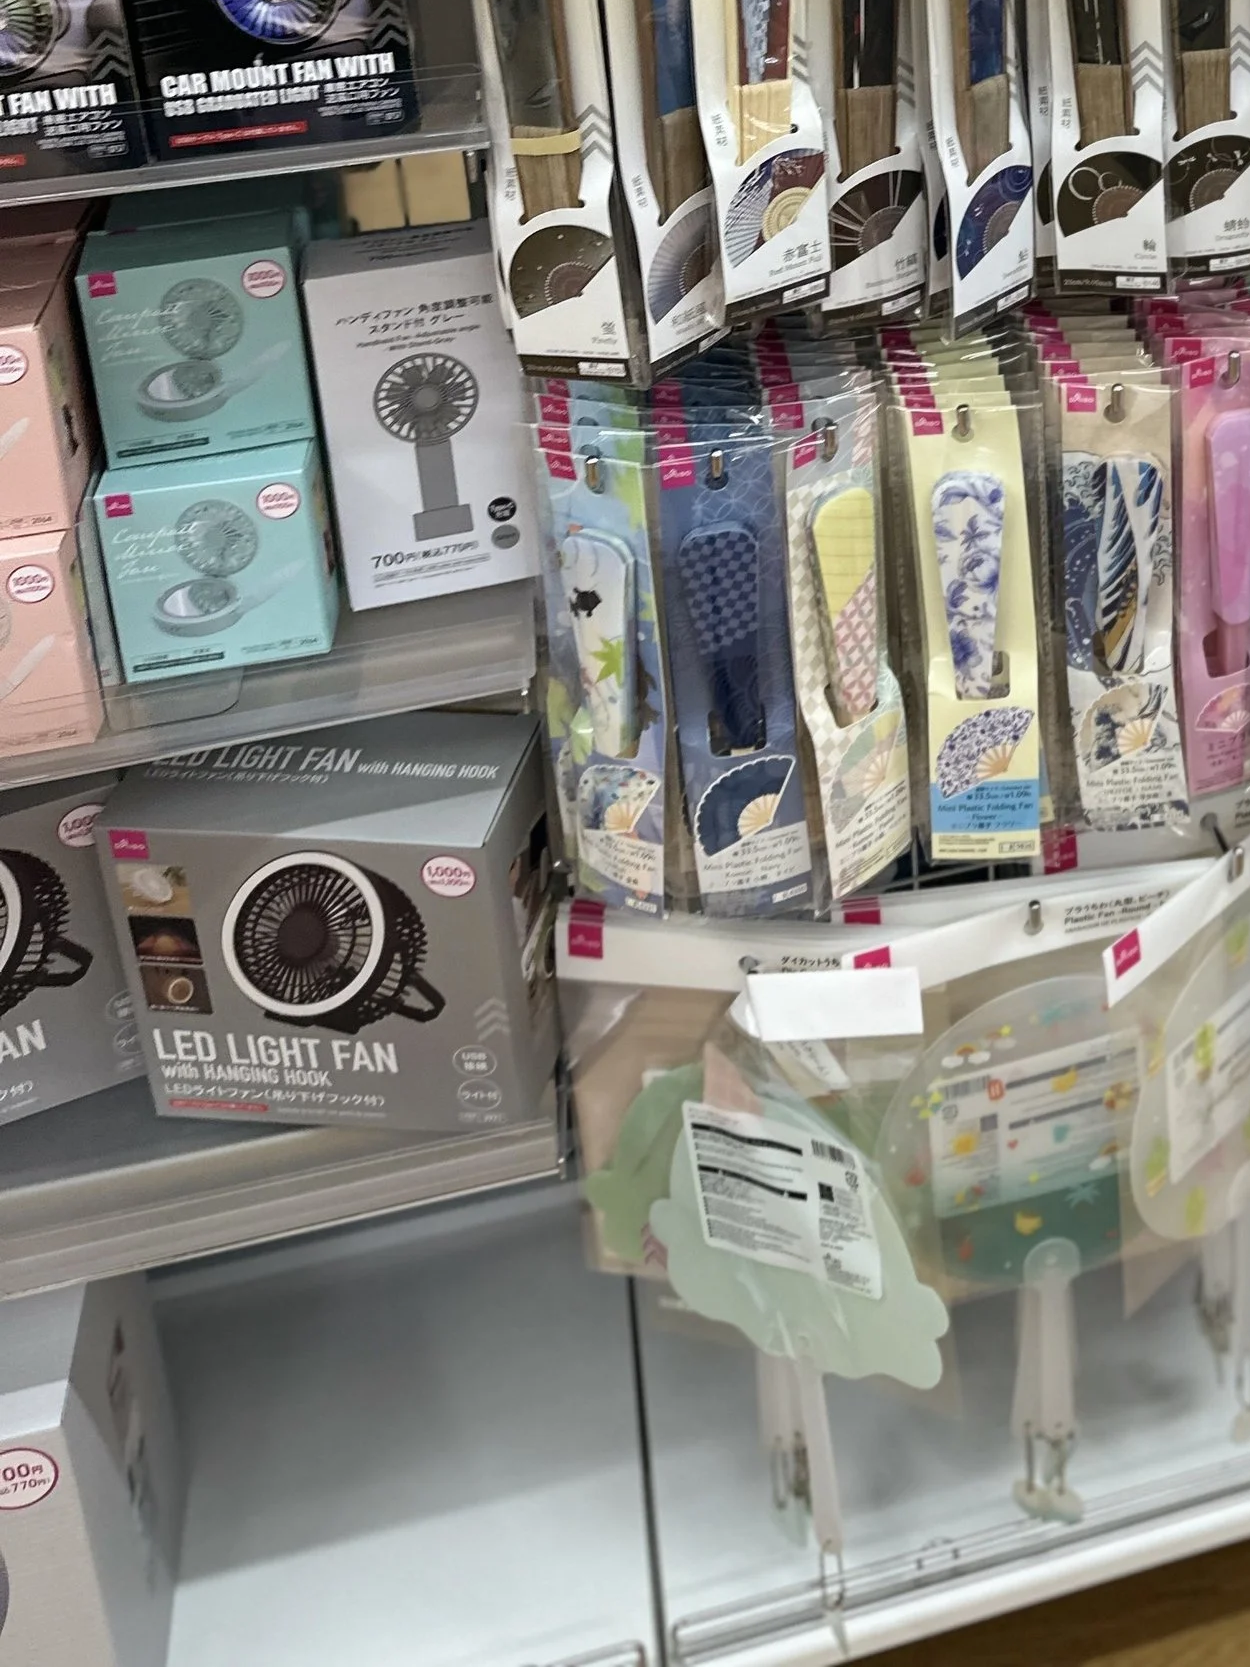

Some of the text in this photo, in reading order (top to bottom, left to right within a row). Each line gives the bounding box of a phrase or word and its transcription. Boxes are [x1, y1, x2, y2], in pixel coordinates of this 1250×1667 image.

[160, 51, 396, 98] CAR MOUNT FAN WITH
[9, 82, 118, 117] FAN WITH
[783, 240, 822, 263] 赤富士
[336, 307, 415, 326] ハンディファン
[429, 314, 466, 325] グレー
[213, 745, 302, 772] LIGHT
[300, 747, 363, 774] FAN
[358, 758, 390, 775] with
[391, 761, 459, 778] HANGING
[459, 765, 501, 780] HOOK
[426, 865, 471, 879] 1,000円
[1064, 911, 1095, 926] Plastic
[1097, 908, 1116, 923] Fan
[781, 955, 842, 968] ダイカットうち
[153, 1028, 399, 1074] LED LIGHT FAN
[161, 1062, 333, 1087] with HANGING HOOK
[0, 1461, 44, 1482] 00円
